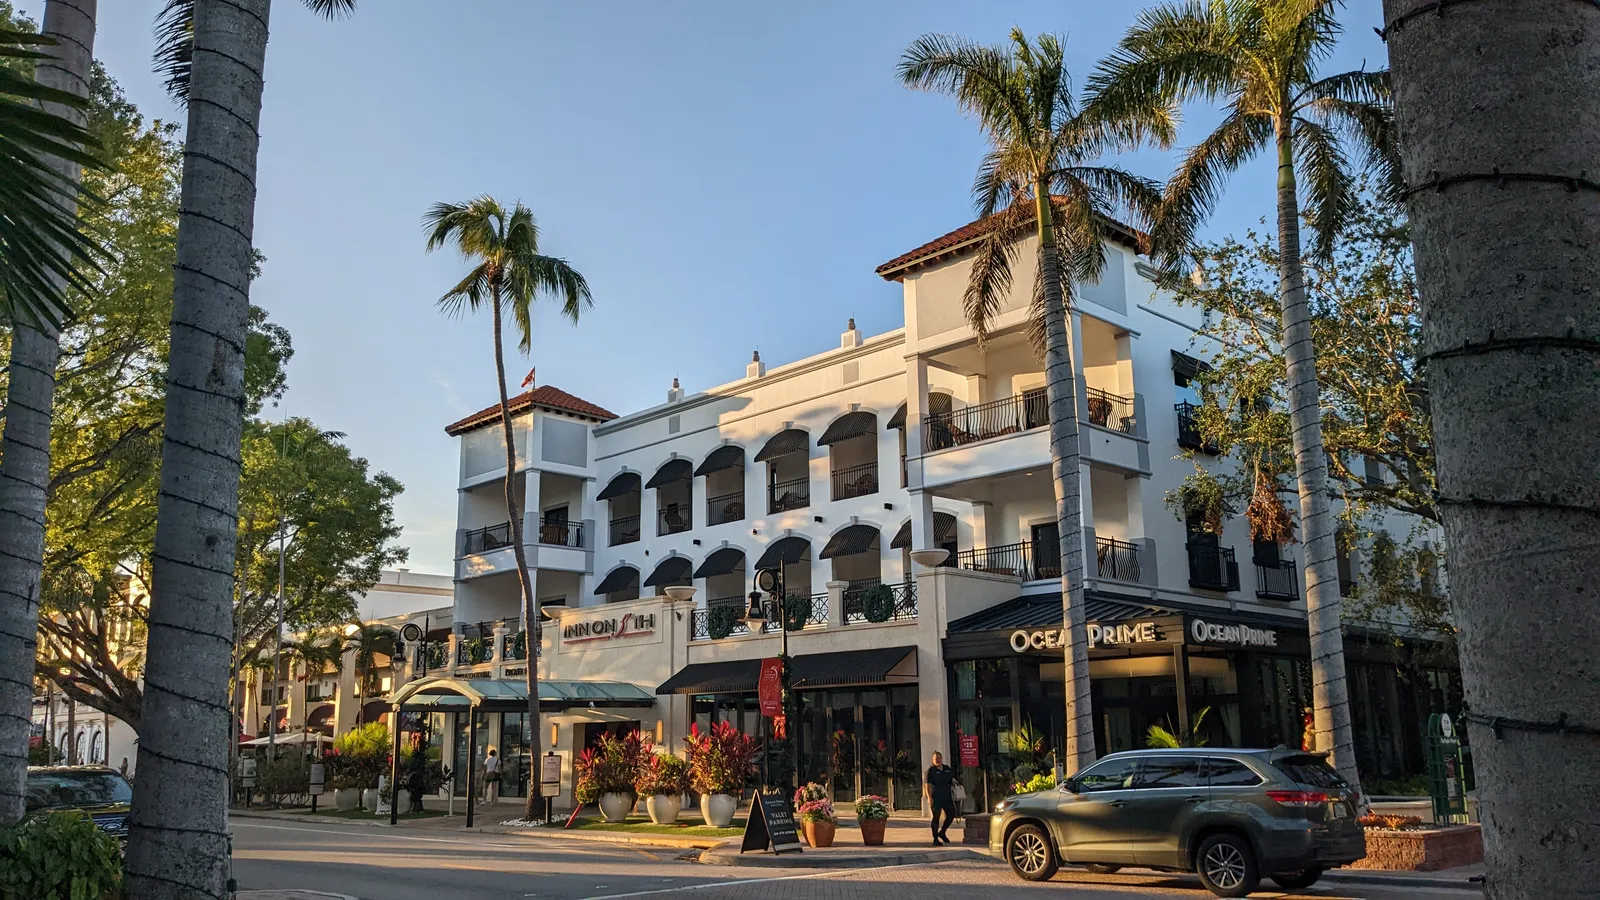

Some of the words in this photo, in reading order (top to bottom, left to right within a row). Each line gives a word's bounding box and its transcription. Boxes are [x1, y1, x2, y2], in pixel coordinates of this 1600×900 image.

[564, 622, 589, 638] INN
[592, 618, 616, 634] ON
[1010, 628, 1065, 653] OCEA
[1086, 621, 1156, 649] PRIME
[1191, 618, 1240, 643] OCEAN
[1239, 623, 1278, 647] PRIME
